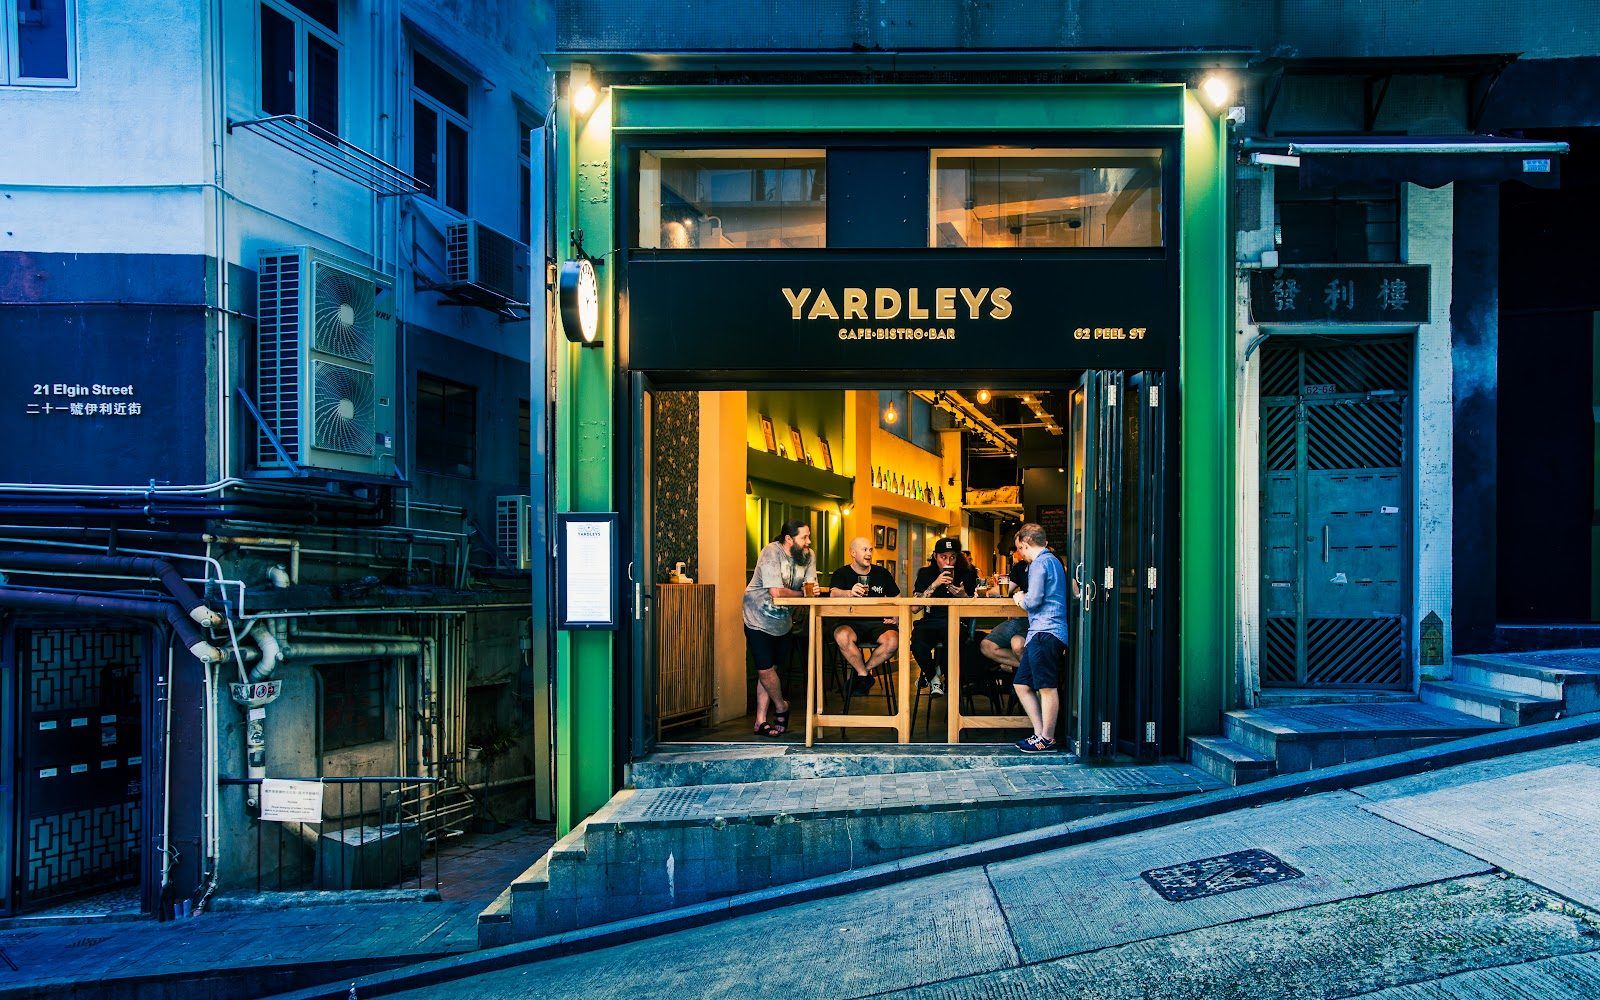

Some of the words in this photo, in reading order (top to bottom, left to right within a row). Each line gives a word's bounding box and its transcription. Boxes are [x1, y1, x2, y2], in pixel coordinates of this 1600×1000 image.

[1270, 278, 1410, 312] 發利樓
[781, 286, 1014, 321] YARDLEYS
[1073, 328, 1091, 340] 62
[1094, 328, 1127, 340] PEEL
[1128, 328, 1147, 340] ST
[33, 384, 50, 396] 21
[53, 384, 90, 398] Elgin
[91, 384, 134, 396] Street
[1306, 385, 1335, 394] 62-64
[26, 401, 142, 416] 二十一號伊利近街
